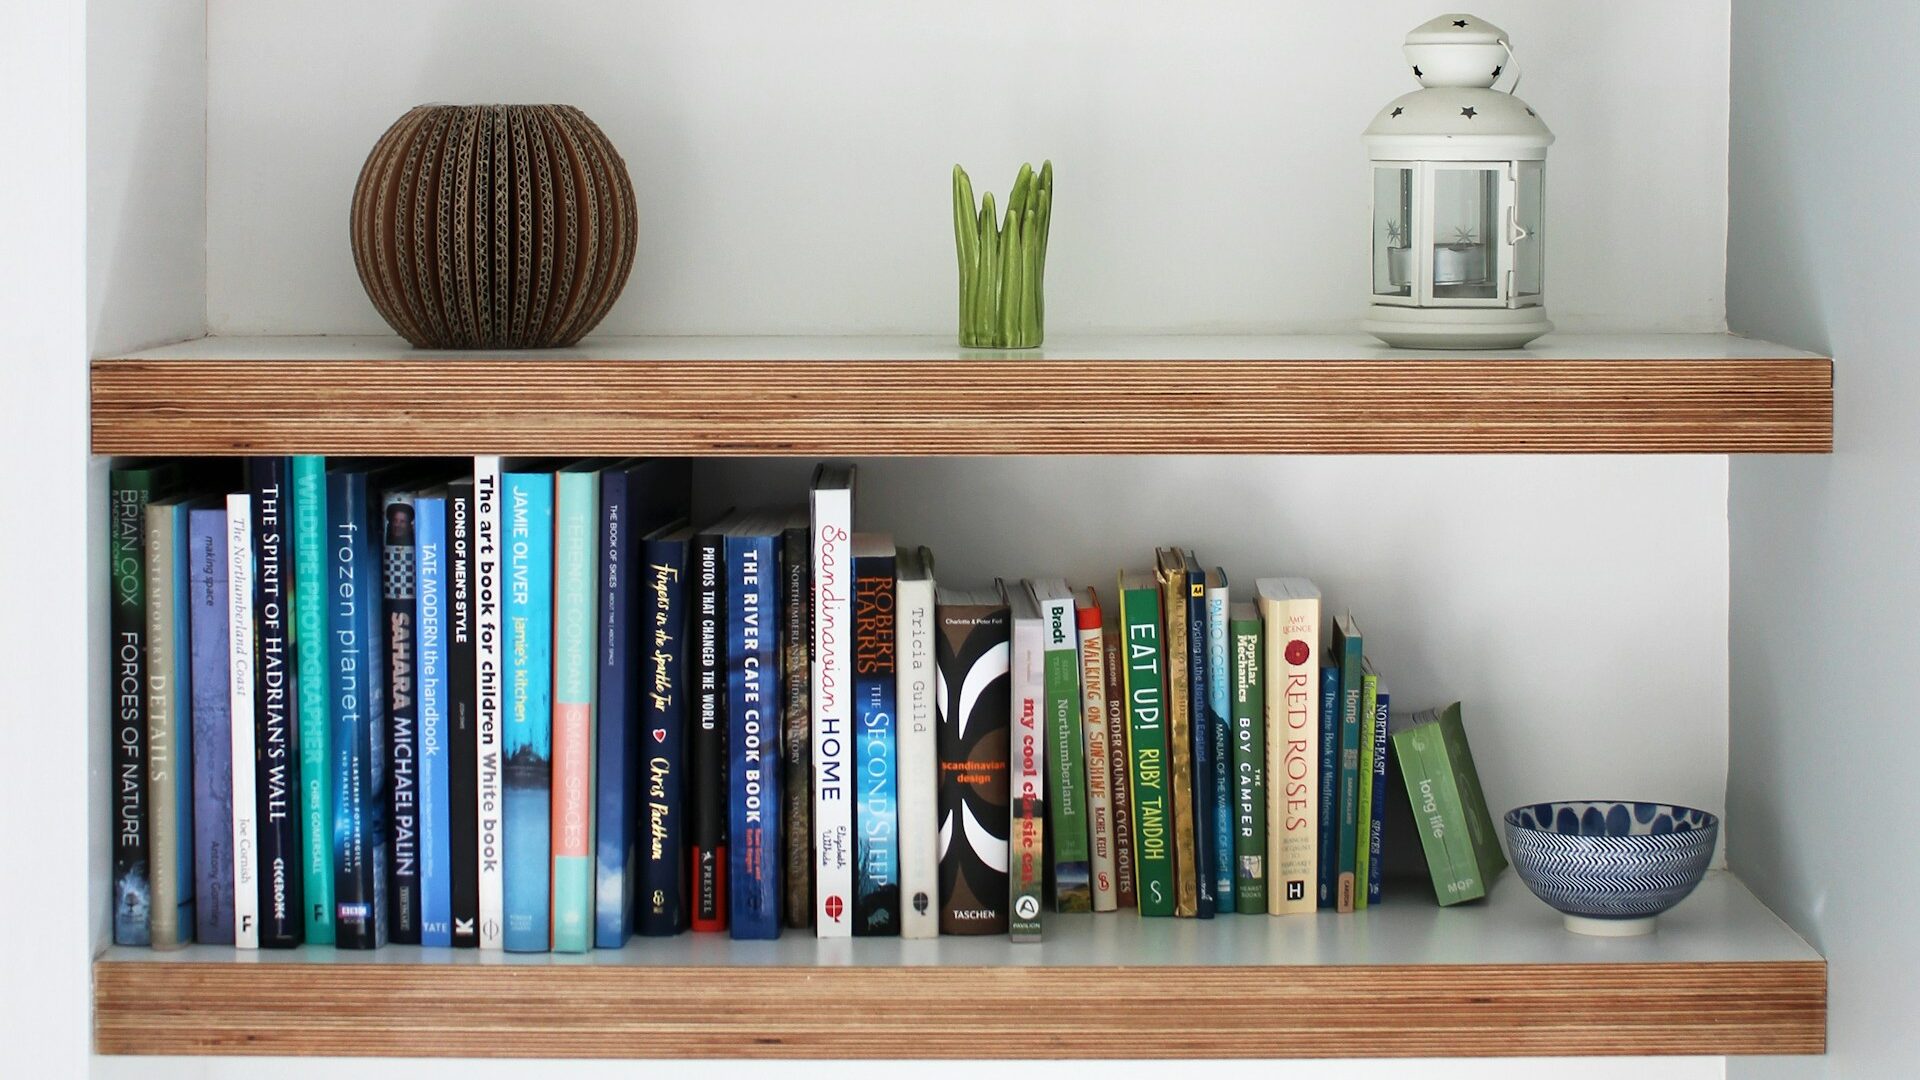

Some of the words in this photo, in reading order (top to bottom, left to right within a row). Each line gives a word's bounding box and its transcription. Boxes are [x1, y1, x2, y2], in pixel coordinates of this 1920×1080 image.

[262, 484, 279, 526] THE
[480, 475, 494, 514] The
[513, 484, 529, 538] JAMIE
[609, 505, 618, 521] THE
[121, 489, 138, 551] BRIAN
[233, 518, 246, 543] The
[298, 474, 319, 575] WILDLIFE
[455, 498, 467, 538] ICONS
[481, 520, 494, 553] art
[609, 522, 618, 547] BOOK
[203, 536, 216, 575] making
[263, 533, 280, 596] SPIRIT
[339, 522, 358, 616] frozen
[422, 543, 437, 575] TATE
[455, 540, 466, 557] OF
[567, 512, 584, 603] TERENCE
[609, 549, 617, 561] OF
[703, 547, 716, 587] PHOTOS
[744, 550, 758, 585] THE
[121, 557, 138, 605] COX
[203, 577, 215, 606] space
[456, 560, 467, 599] MEN'S
[481, 562, 496, 616] book
[513, 541, 528, 605] OLIVER
[608, 563, 617, 588] SKIES
[649, 564, 678, 610] Fingers
[151, 529, 162, 665] CONTEMPORARY
[234, 546, 248, 655] Northumberland
[265, 603, 279, 629] OF
[423, 579, 439, 646] MODERN
[655, 612, 668, 627] in
[703, 590, 715, 616] THAT
[821, 525, 847, 713] Scandinavian
[1210, 600, 1223, 639] PAULO
[456, 601, 467, 643] STYLE
[482, 622, 496, 655] for
[514, 616, 528, 665] jamie's
[654, 629, 674, 648] the
[703, 620, 715, 667] CHANGED
[744, 594, 758, 651] RIVER
[856, 577, 876, 674] HARRIS
[874, 577, 894, 674] ROBERT
[911, 608, 925, 670] Tricia
[1051, 606, 1066, 644] Bradt
[1193, 620, 1204, 654] Cycling
[392, 613, 412, 710] SAHARA
[425, 650, 439, 675] the
[566, 608, 582, 696] CONRAN
[651, 649, 674, 692] Sparkle
[1083, 636, 1103, 700] WALKING
[1130, 623, 1157, 675] EAT
[1194, 655, 1203, 665] in
[1236, 634, 1248, 702] Mechanics
[1244, 634, 1259, 685] Popular
[122, 632, 138, 720] FORCES
[236, 660, 248, 696] Coast
[301, 582, 325, 764] PHOTOGRAPHER
[337, 630, 361, 722] planet
[515, 669, 528, 722] kitchen
[702, 671, 715, 690] THE
[744, 657, 759, 703] CAFE
[1195, 667, 1204, 681] the
[1211, 644, 1225, 702] COELHO
[265, 638, 286, 760] HADRIAN'S
[425, 677, 440, 755] handbook
[482, 661, 497, 745] children
[649, 692, 672, 712] Jar
[702, 694, 715, 730] WORLD
[790, 675, 801, 717] HIDDEN
[871, 684, 882, 709] THE
[912, 681, 926, 734] Guild
[1020, 698, 1036, 729] my
[1088, 706, 1102, 724] ON
[1134, 688, 1161, 731] UP!
[1195, 683, 1205, 710] North
[1284, 674, 1308, 729] RED
[1325, 691, 1336, 708] The
[1346, 689, 1360, 724] Home
[122, 727, 139, 758] OF
[150, 674, 167, 782] DETAILS
[565, 709, 581, 768] SMALL
[745, 709, 760, 763] COOK
[790, 720, 801, 766] HISTORY
[1110, 700, 1122, 746] BORDER
[1195, 724, 1206, 762] England
[1215, 723, 1225, 760] MANUAL
[1239, 718, 1252, 752] BOY
[1324, 732, 1335, 756] Book
[1374, 704, 1388, 775] NORTH-EAST
[393, 717, 414, 812] MICHAEL
[649, 757, 671, 798] Chris
[822, 719, 841, 801] HOME
[864, 712, 890, 815] SECOND
[942, 761, 1005, 770] scandinavian
[1023, 734, 1038, 777] cool
[1057, 698, 1075, 815] Northumberland
[1090, 731, 1107, 800] SUNSHINE
[1112, 750, 1126, 805] COUNTRY
[1138, 749, 1162, 789] RUBY
[1216, 761, 1225, 774] OF
[1324, 758, 1334, 768] of
[269, 765, 286, 823] WALL
[310, 780, 321, 809] CHRIS
[483, 752, 497, 812] White
[746, 769, 761, 823] BOOK
[957, 774, 992, 784] design
[1217, 776, 1226, 793] THE
[1240, 763, 1254, 837] CAMPER
[1283, 739, 1308, 832] ROSES
[1322, 771, 1334, 826] Mindfulness
[122, 764, 140, 847] NATURE
[239, 818, 250, 836] Joe
[564, 775, 580, 848] SPACES
[1095, 807, 1105, 835] RACHEL
[1116, 810, 1128, 845] CYCLE
[1140, 795, 1165, 860] TANDOH
[1217, 794, 1227, 832] WARRIOR
[1419, 779, 1437, 812] long
[1429, 814, 1445, 839] life
[311, 812, 322, 875] GOMERSALL
[396, 816, 415, 875] PALIN
[484, 818, 497, 873] book
[649, 802, 669, 861] Packham
[833, 825, 847, 870] Elizabeth
[866, 820, 891, 888] SLEEP
[1096, 837, 1107, 860] KELLY
[1219, 834, 1228, 847] OF
[1371, 819, 1381, 854] SPACES
[239, 839, 251, 884] Cornish
[1118, 848, 1131, 893] ROUTES
[1219, 849, 1229, 872] LIGHT
[273, 857, 285, 919] CICERONE
[703, 866, 713, 914] PRESTEL
[1289, 883, 1301, 898] H
[1447, 878, 1475, 893] MQP
[423, 922, 447, 933] TATE
[953, 909, 996, 919] TASCHEN
